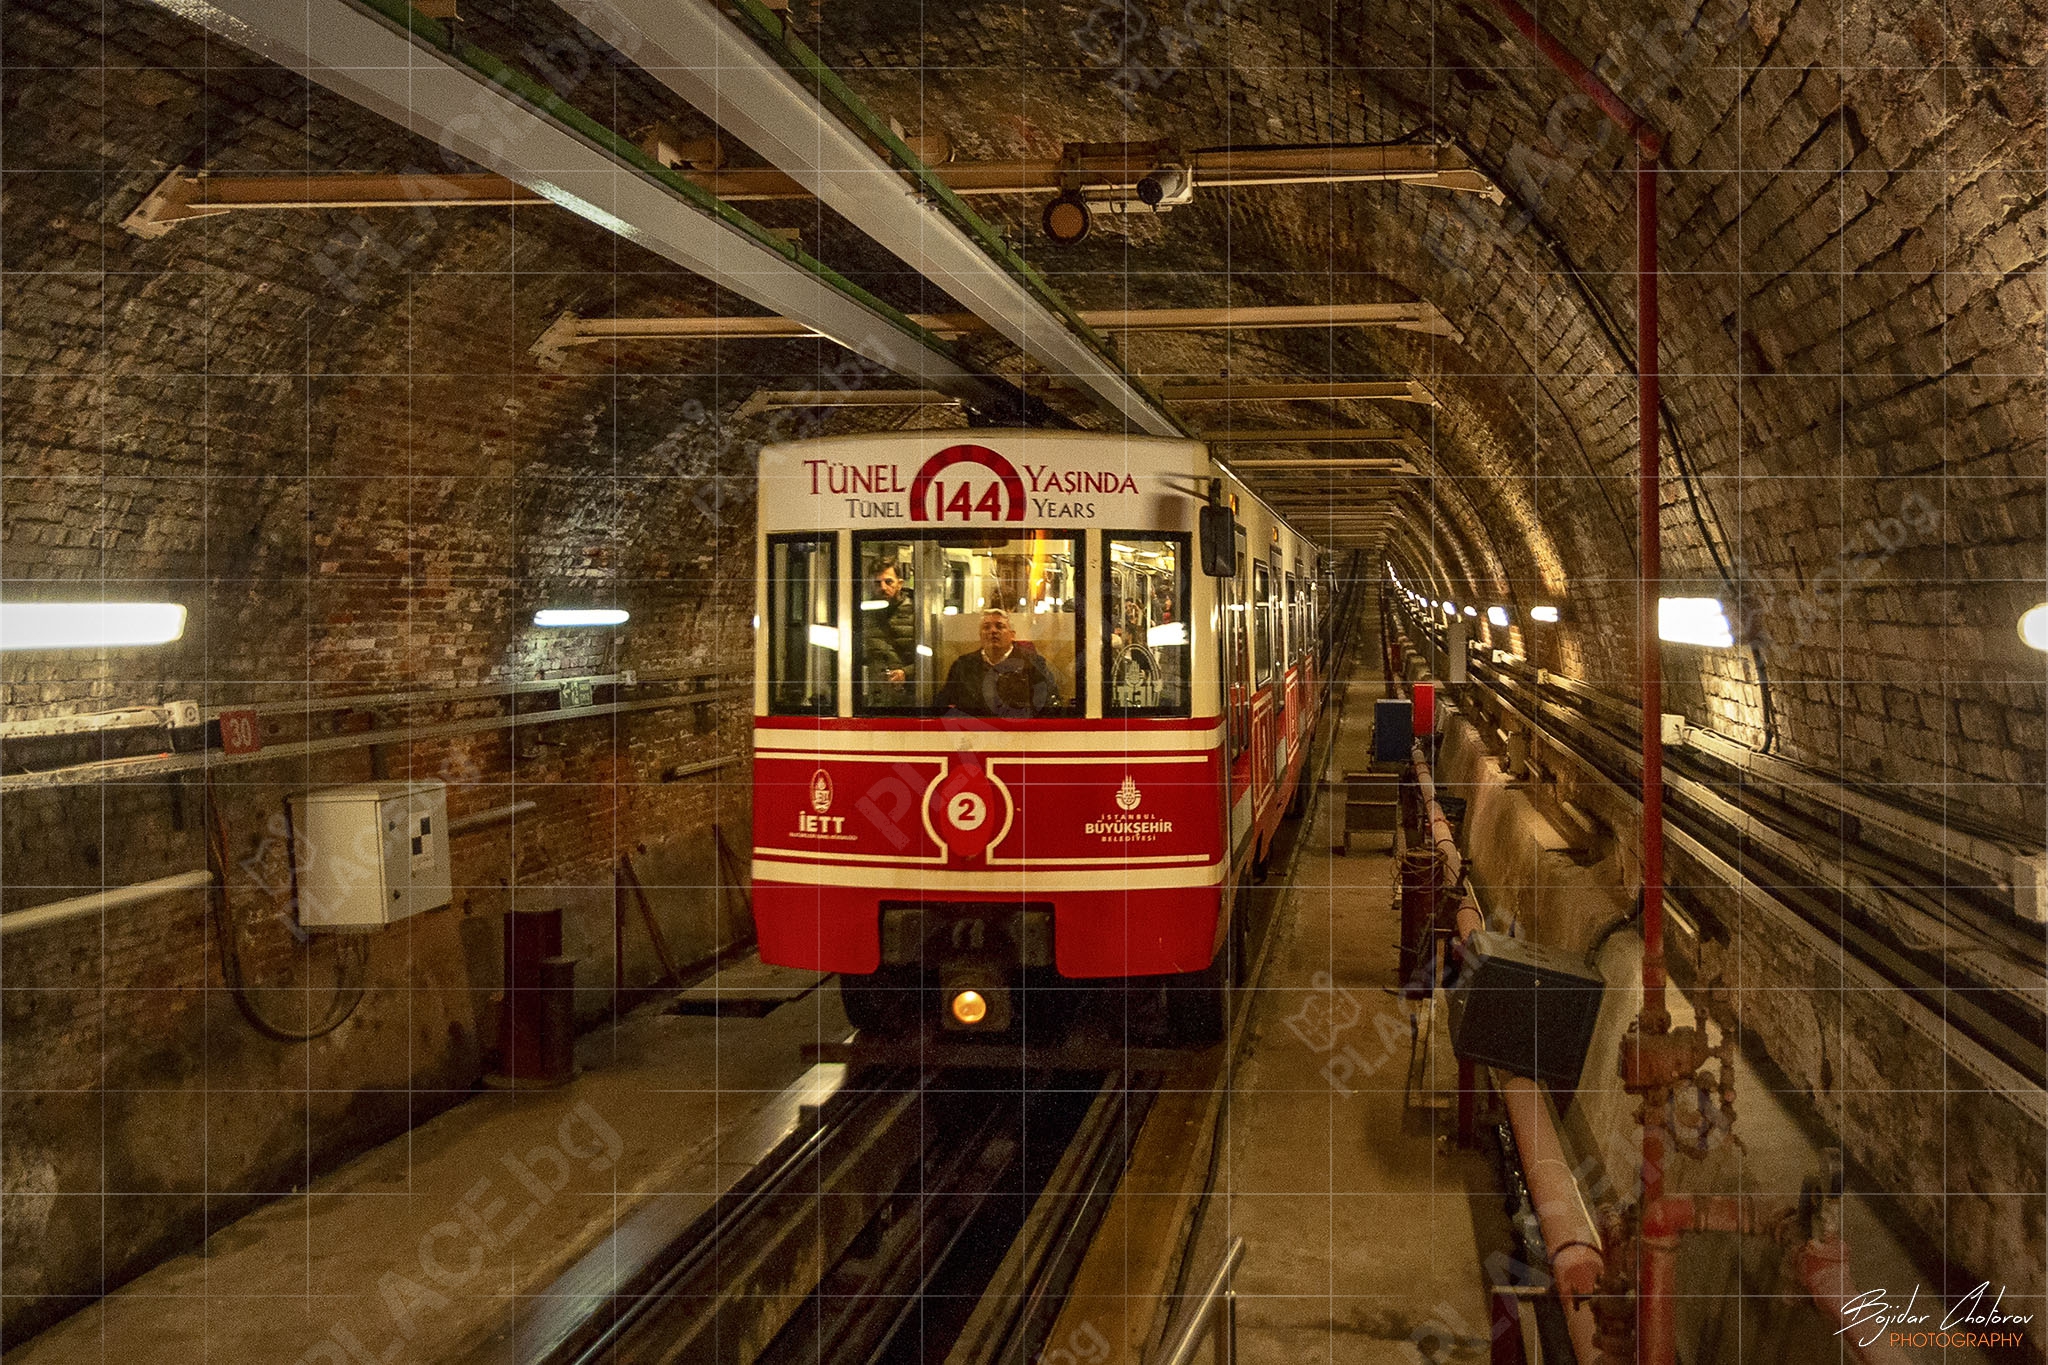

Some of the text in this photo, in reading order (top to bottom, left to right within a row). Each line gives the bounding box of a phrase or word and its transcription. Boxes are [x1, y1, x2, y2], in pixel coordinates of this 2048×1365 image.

[804, 459, 1140, 522] TÜNEL 144 YAŞINDA
[845, 498, 1096, 519] TÜNEL YEARS
[229, 717, 252, 748] 30
[957, 797, 976, 821] 2
[799, 810, 845, 834] İETT
[1084, 818, 1173, 837] BÜYÜKŞEHİR
